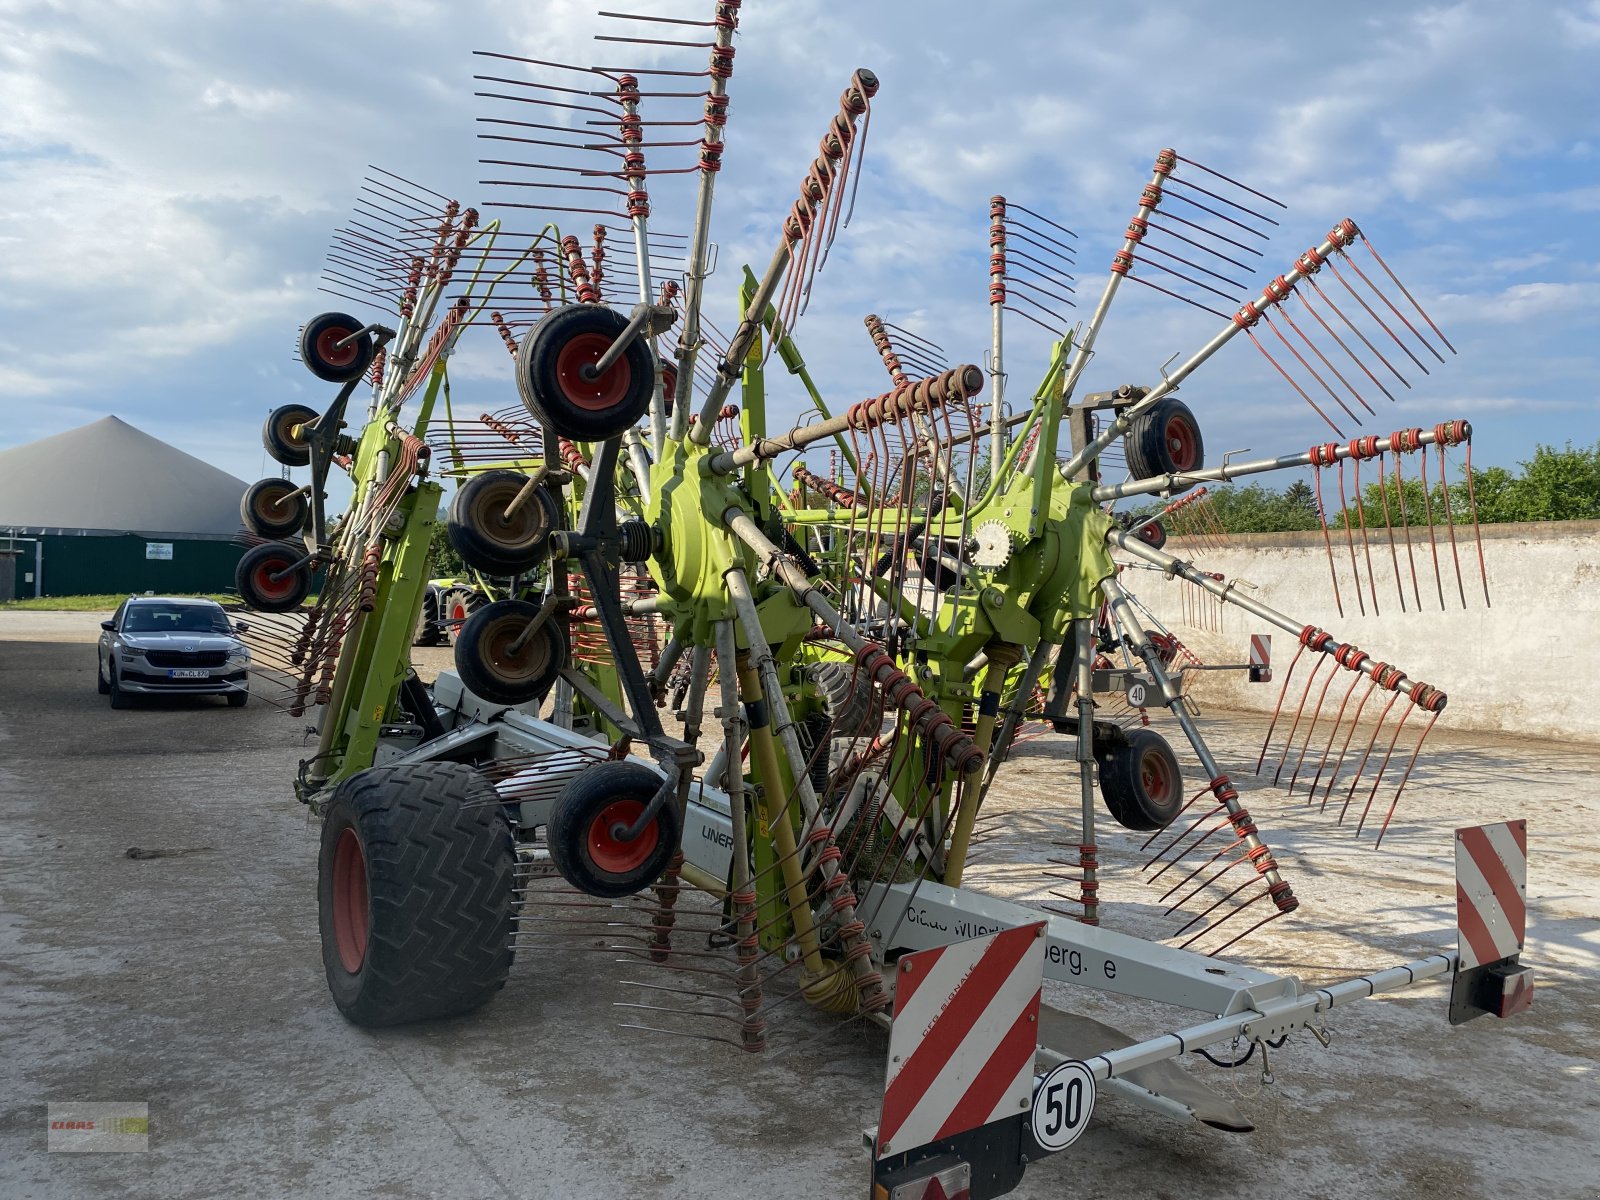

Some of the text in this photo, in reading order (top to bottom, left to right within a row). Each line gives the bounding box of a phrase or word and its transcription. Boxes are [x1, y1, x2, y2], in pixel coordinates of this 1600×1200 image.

[1132, 687, 1143, 701] 40
[702, 825, 733, 850] LINER
[1045, 1077, 1083, 1136] 50
